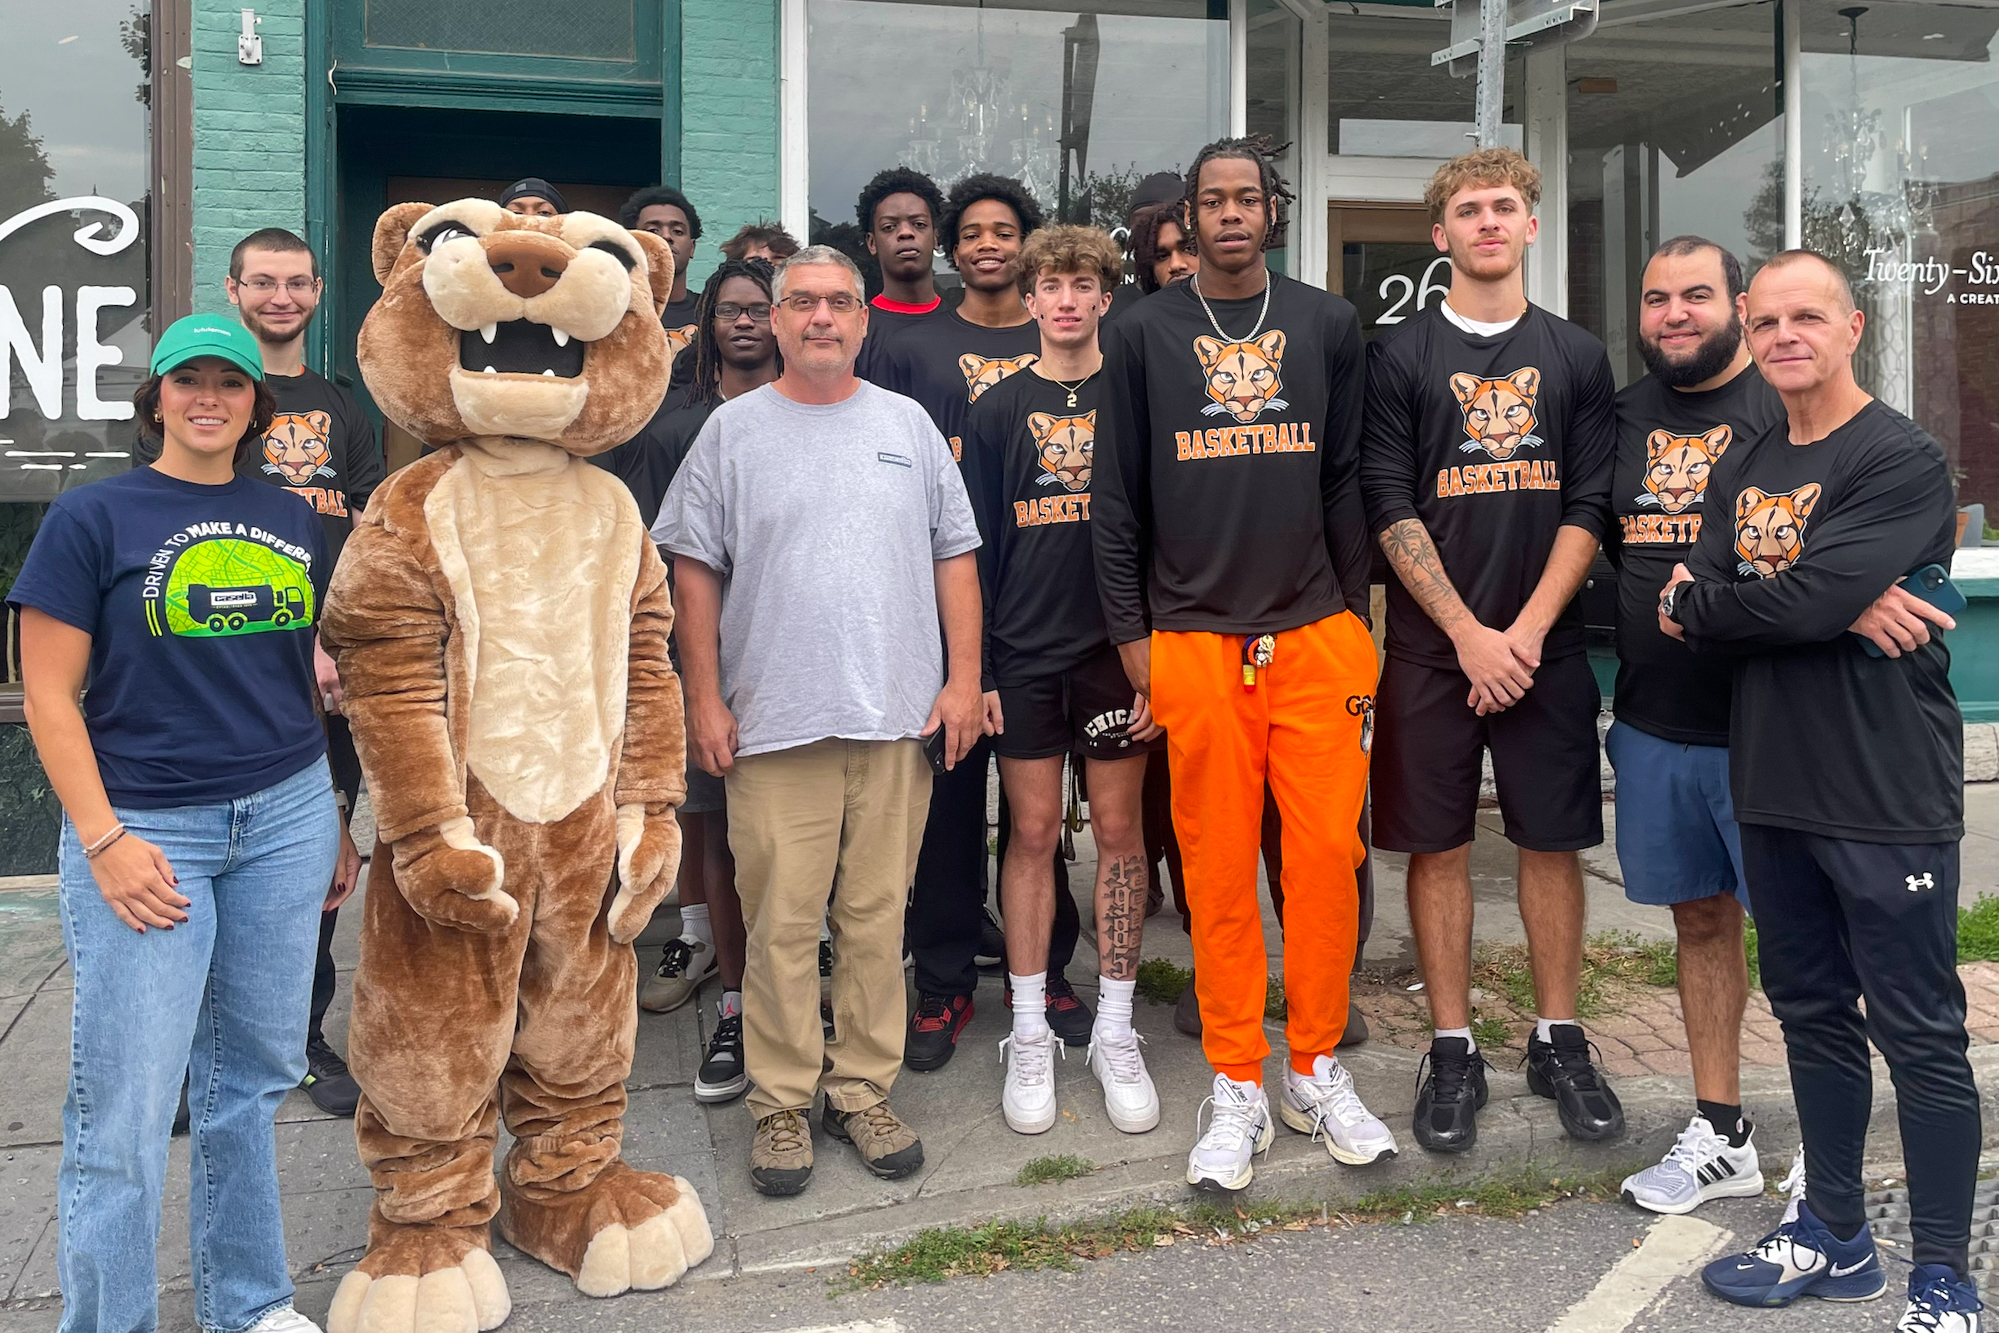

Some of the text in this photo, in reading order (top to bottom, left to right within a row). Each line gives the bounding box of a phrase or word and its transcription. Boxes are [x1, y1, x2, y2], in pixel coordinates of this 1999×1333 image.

[1375, 256, 1452, 325] 26
[1946, 293, 1956, 304] A
[0, 285, 137, 421] NE
[1067, 393, 1077, 407] 2
[1175, 422, 1316, 461] BASKETBALL
[1437, 460, 1560, 498] BASKETBALL
[142, 549, 175, 598] DRIVEN
[164, 533, 189, 548] TO
[186, 521, 233, 538] MAKE
[235, 523, 247, 536] A
[1111, 854, 1132, 980] 1985
